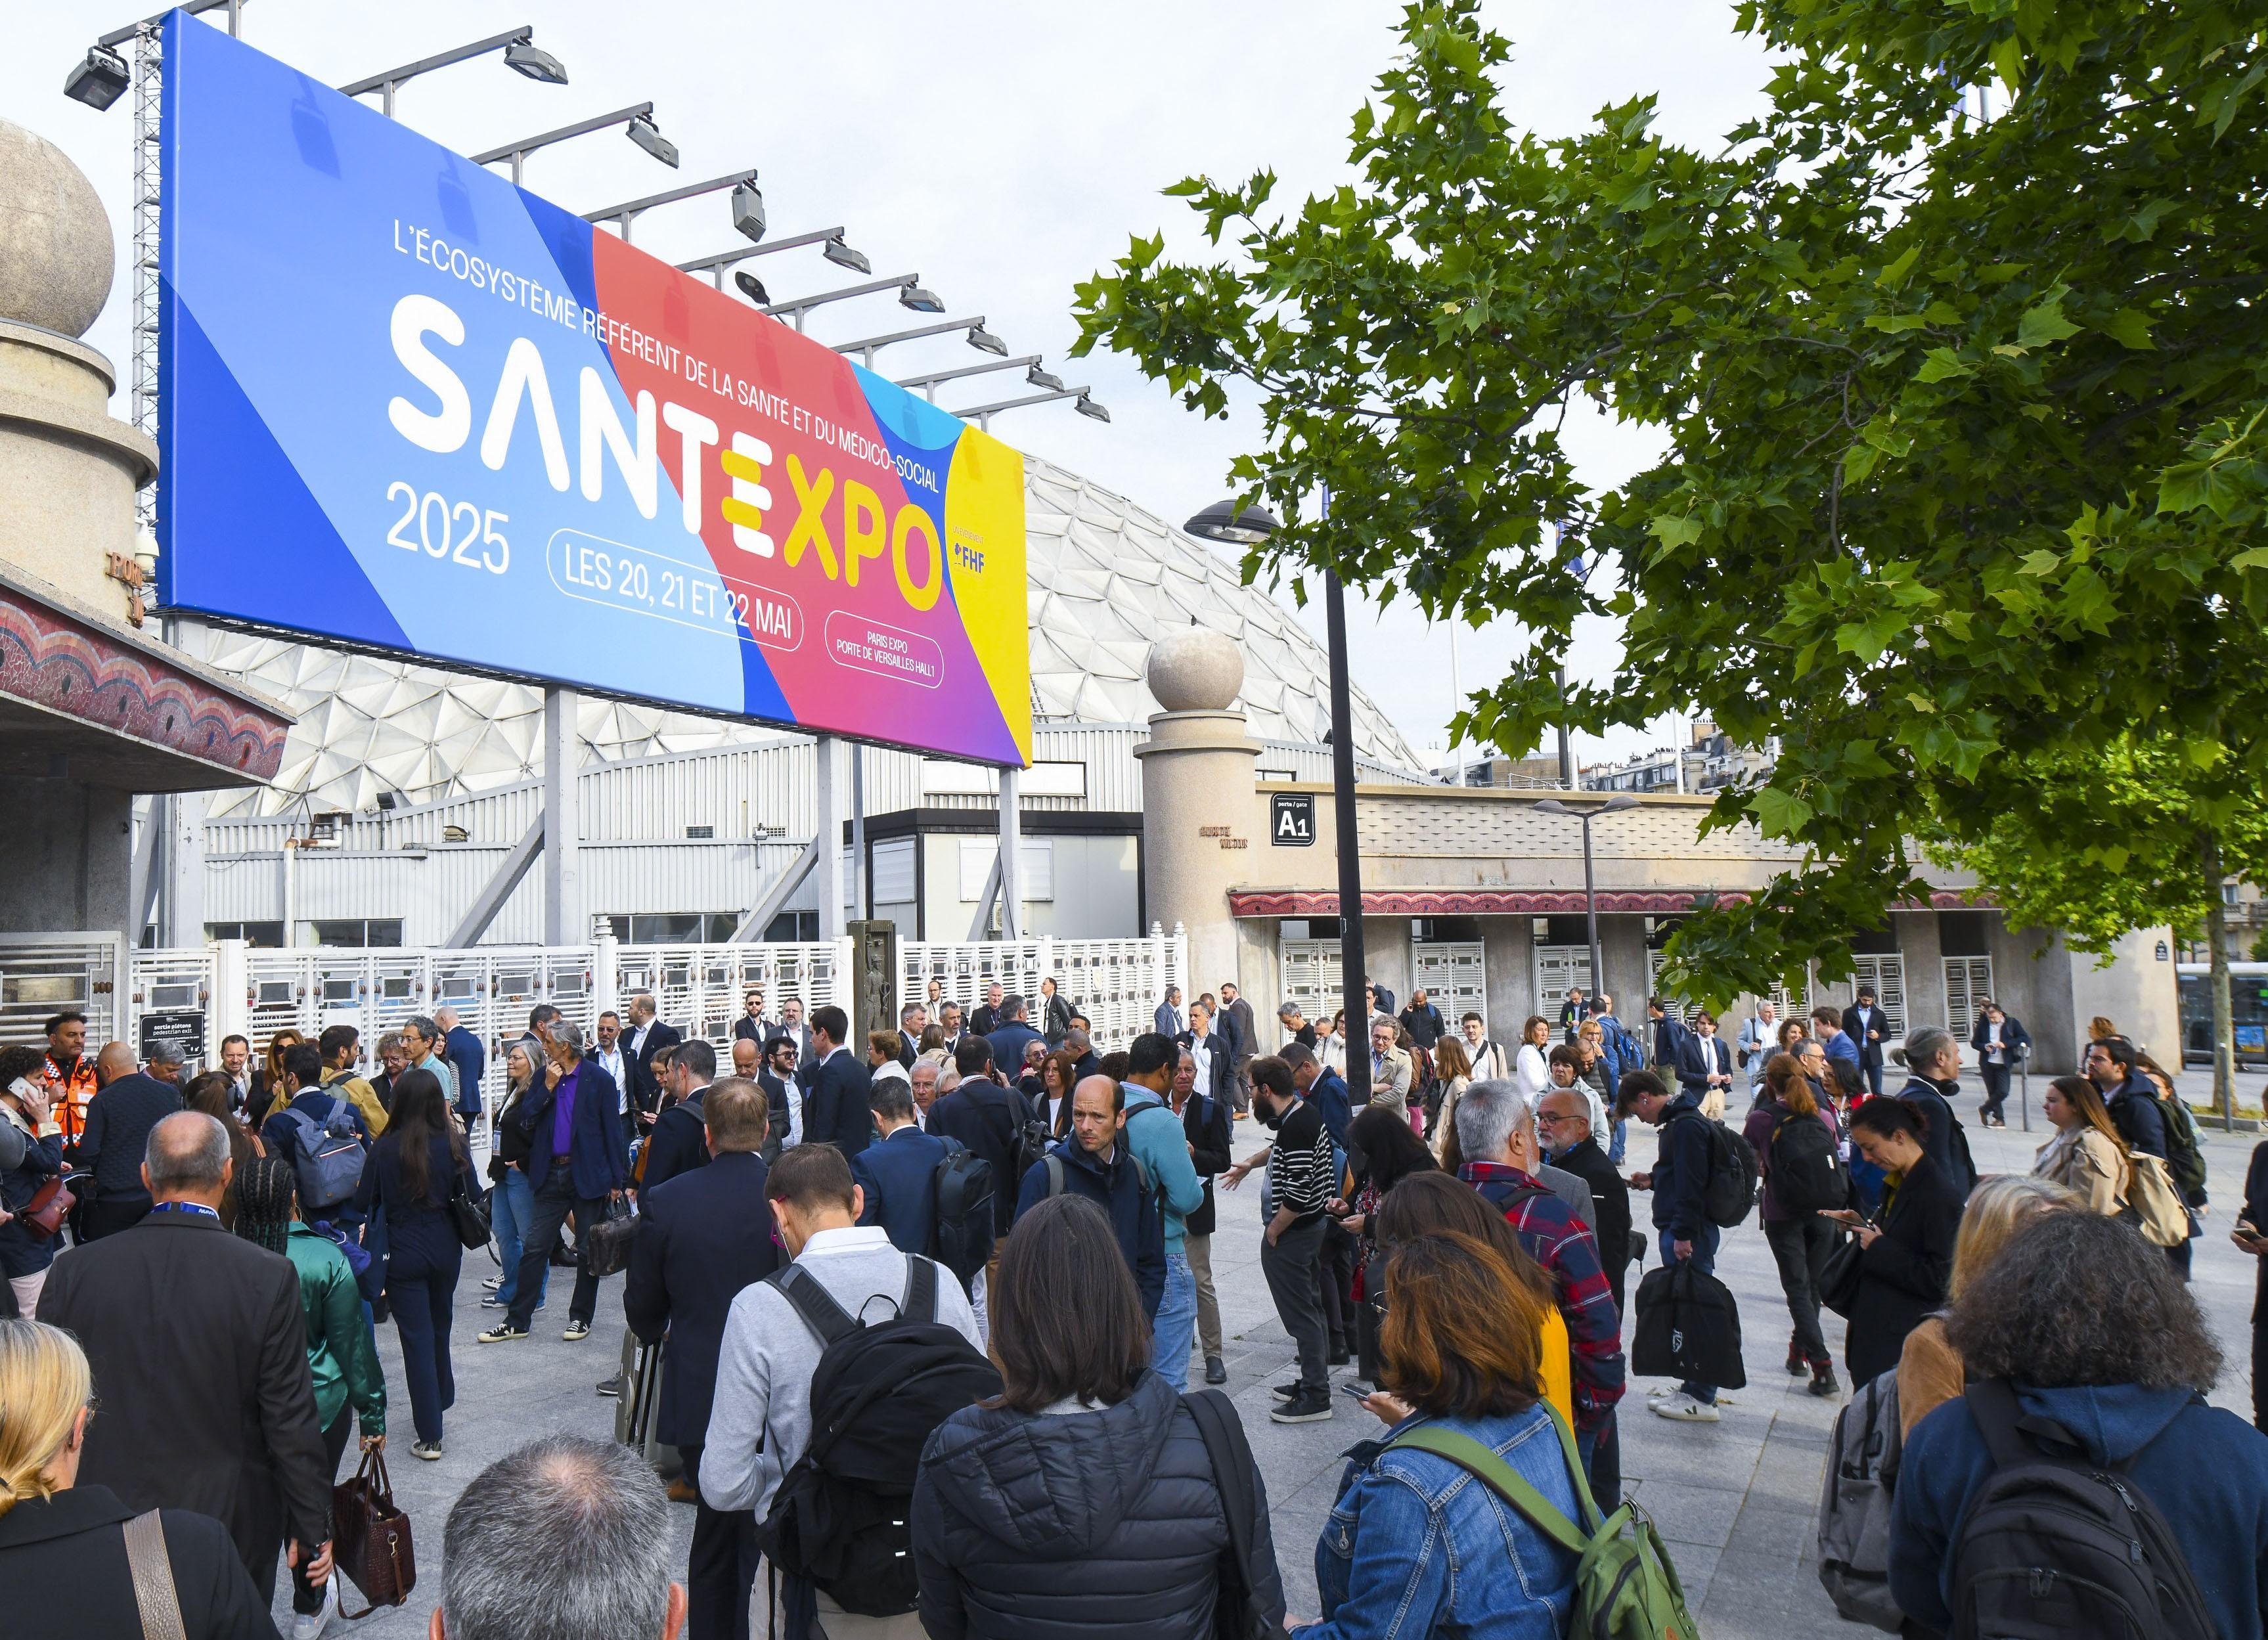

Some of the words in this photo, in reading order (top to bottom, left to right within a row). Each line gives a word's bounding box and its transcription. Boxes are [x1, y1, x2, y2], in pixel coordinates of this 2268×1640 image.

[394, 219, 576, 330] L'ÉCOSYSTÈME
[583, 307, 680, 374] RÉFÉRENT
[686, 355, 707, 389] DE
[713, 367, 734, 400] LA
[738, 379, 789, 426] SANTÉ
[793, 408, 810, 435] ET
[815, 418, 835, 445] DU
[839, 427, 939, 493] MÉDICO-SOCIAL
[388, 293, 943, 611] SANTEXPO
[386, 481, 509, 575] 2025
[962, 546, 985, 573] FHF
[566, 543, 611, 590] LES
[619, 559, 654, 608] 20,
[662, 571, 684, 610] 21
[692, 579, 717, 618] ET
[724, 589, 749, 627] 22
[755, 598, 791, 639] MAI
[837, 638, 861, 657] PORTE
[862, 646, 873, 661] DE
[874, 649, 914, 671] VERSAILLES
[867, 631, 887, 648] PARIS
[889, 637, 908, 654] EXPO
[1278, 810, 1310, 837] A1
